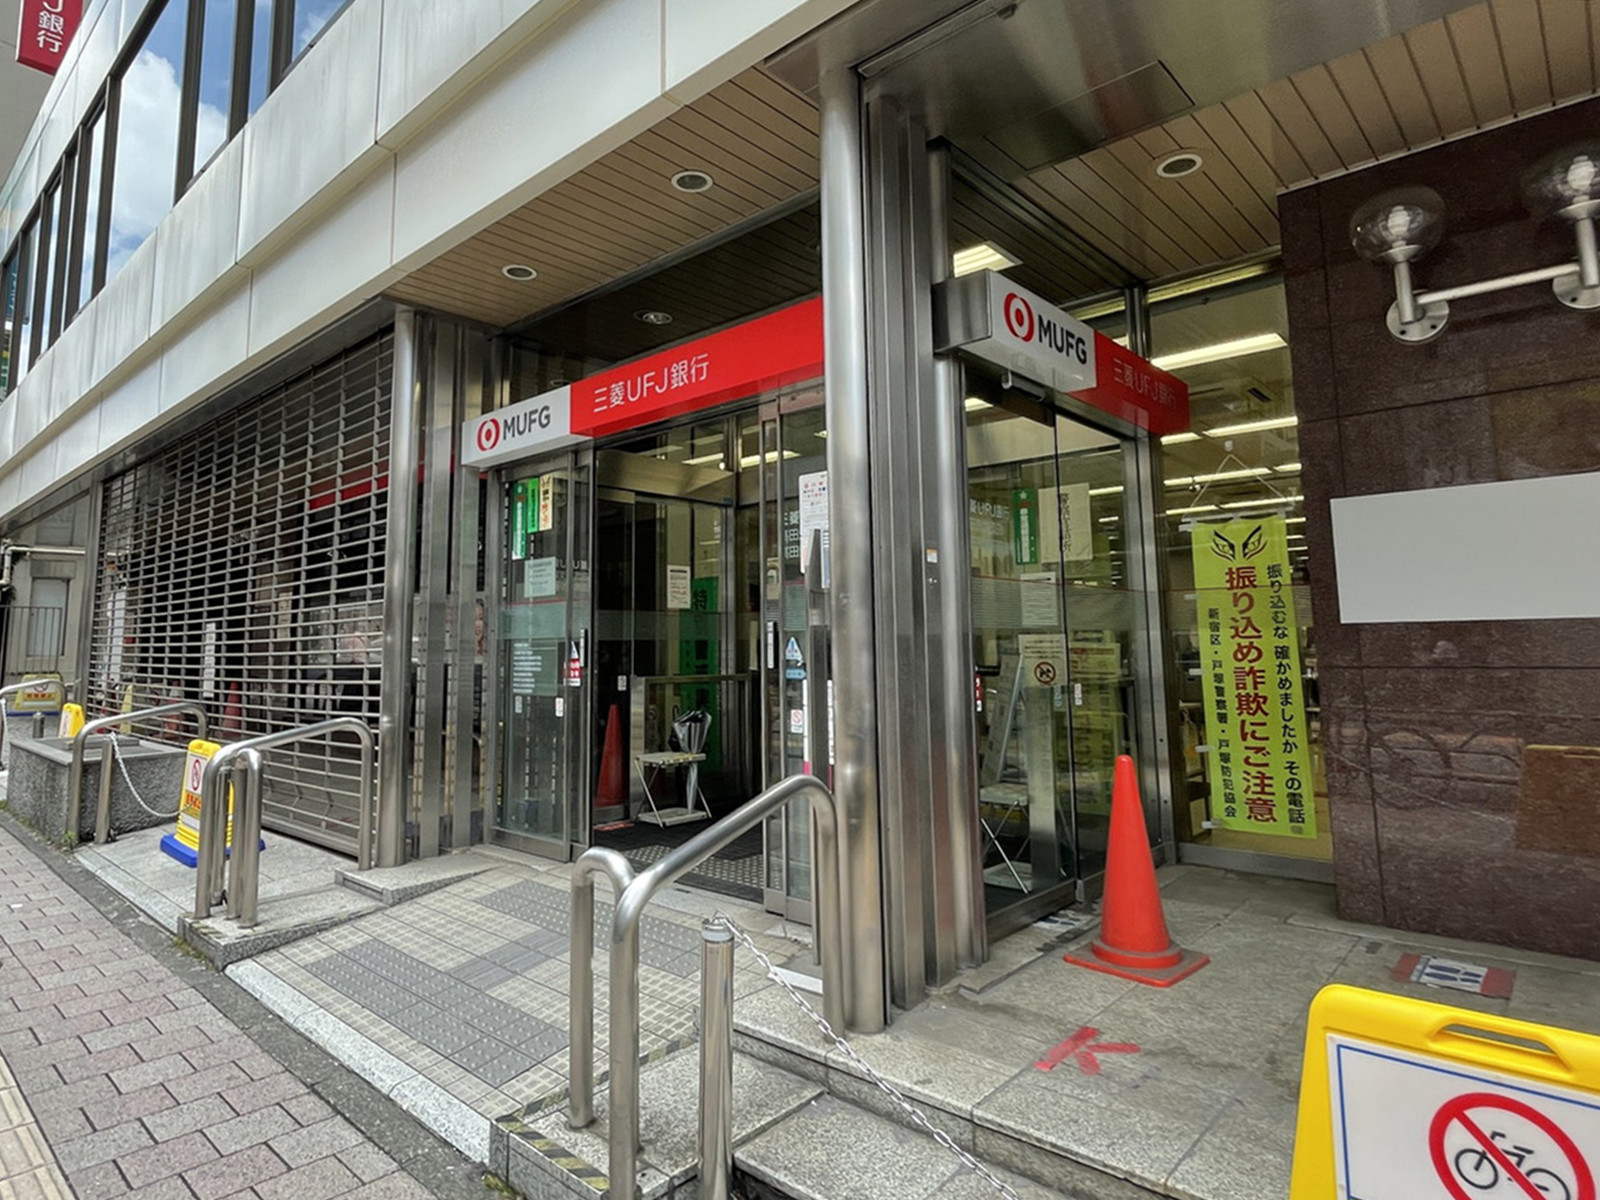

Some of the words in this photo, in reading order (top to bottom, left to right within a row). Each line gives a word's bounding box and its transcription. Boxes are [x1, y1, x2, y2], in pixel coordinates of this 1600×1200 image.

[1038, 314, 1087, 365] MUFG
[593, 353, 710, 413] 三菱UFJ銀行
[1113, 358, 1176, 409] 三菱UFJ銀行
[503, 404, 551, 441] MUFG
[1267, 564, 1288, 639] 振り込むな
[1225, 566, 1278, 822] 振り込め詐欺にご注意
[1274, 645, 1298, 754] 確かめましたか
[1284, 761, 1306, 824] その電話
